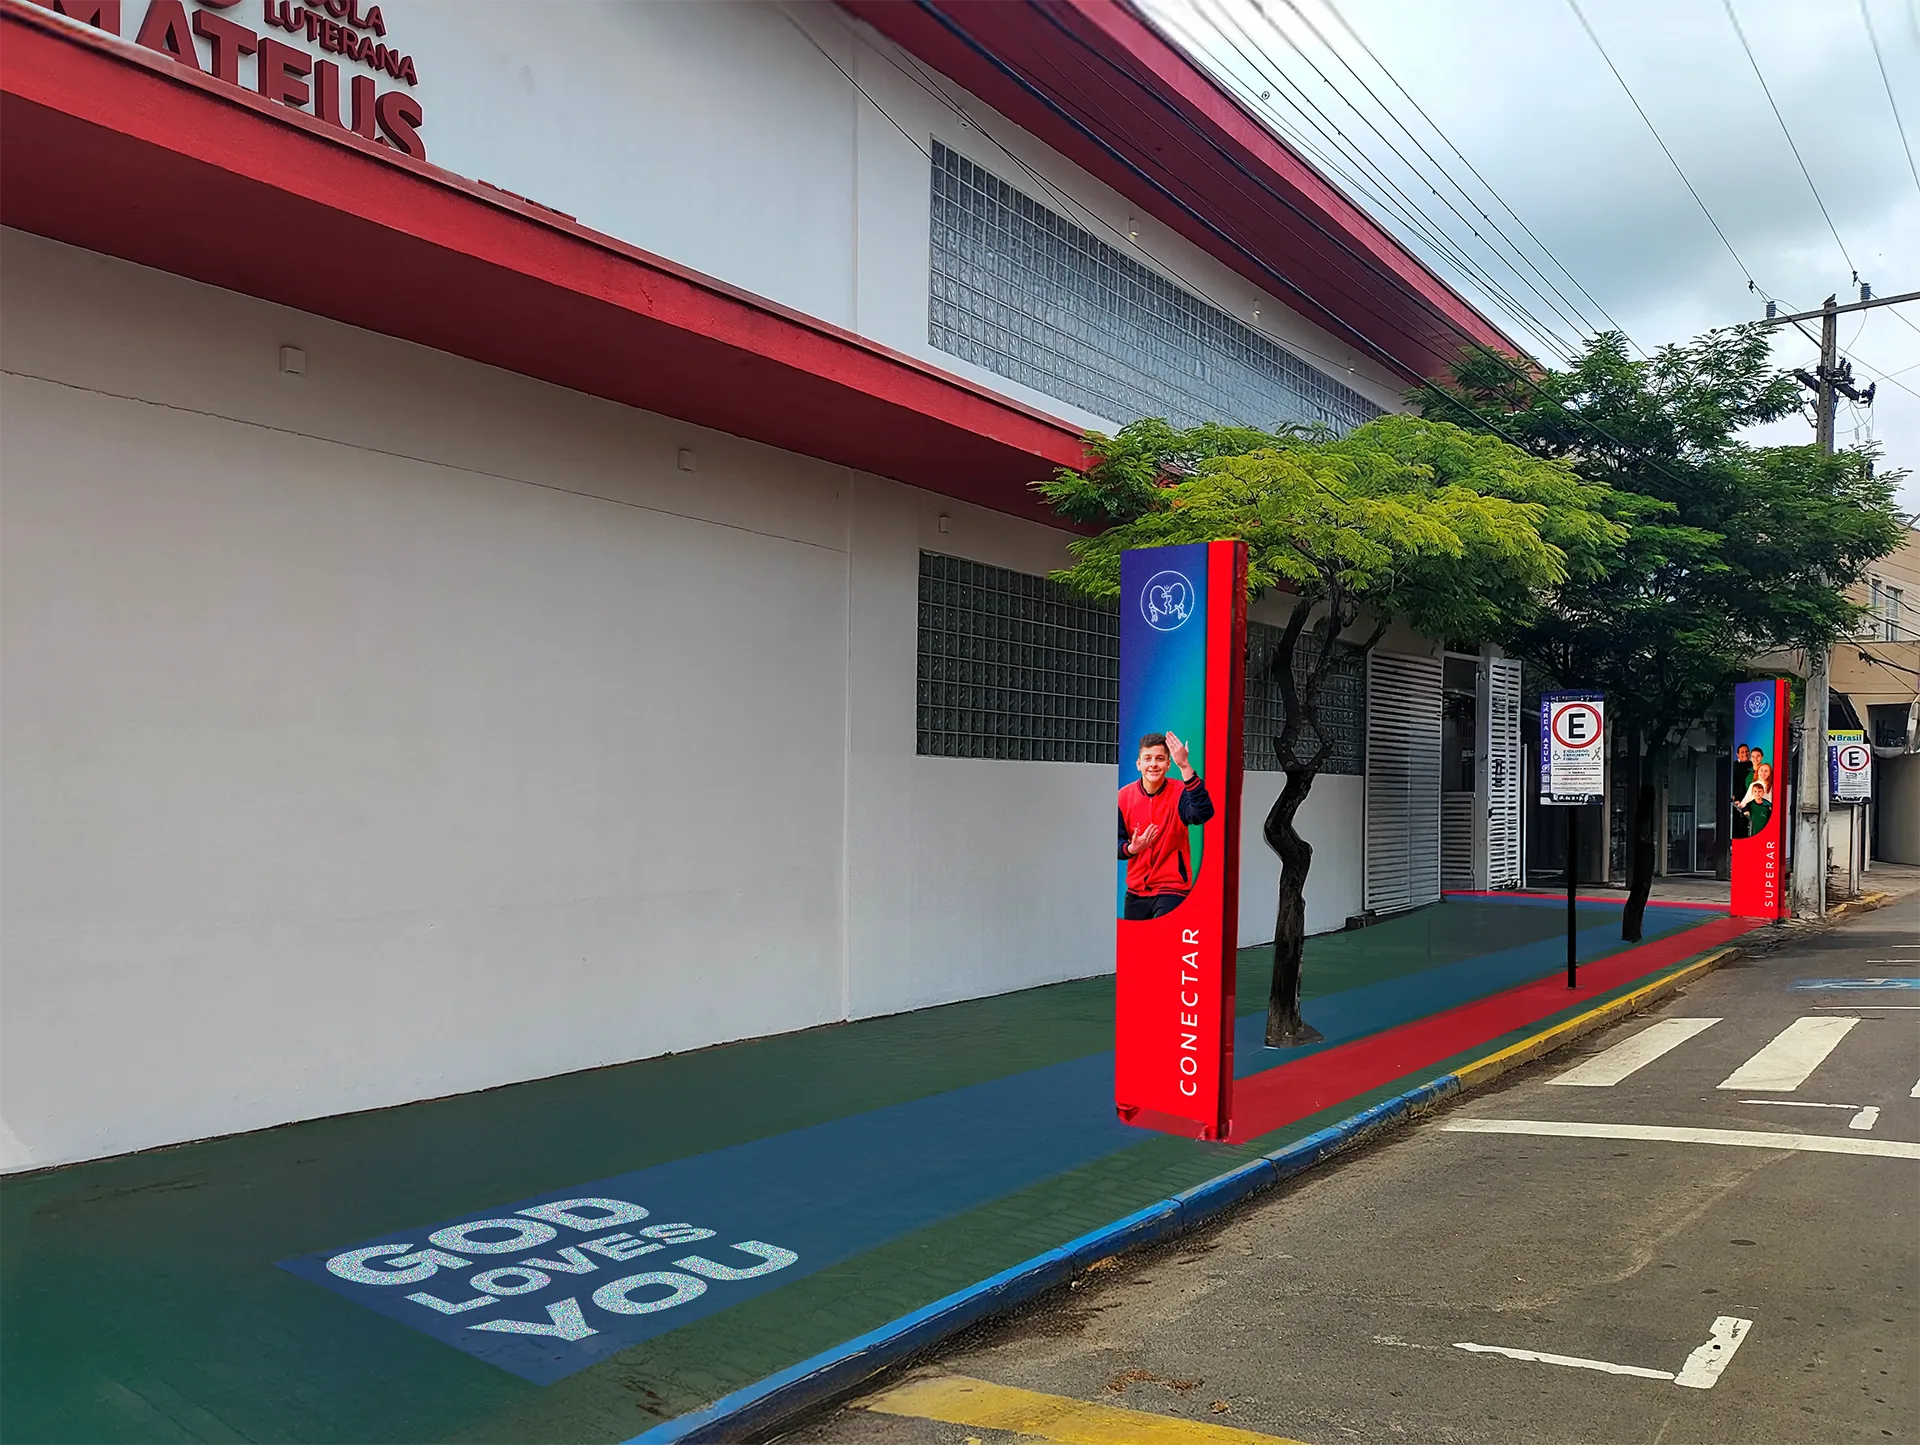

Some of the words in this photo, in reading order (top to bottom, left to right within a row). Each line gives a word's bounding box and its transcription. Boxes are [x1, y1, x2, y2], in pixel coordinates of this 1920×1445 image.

[263, 0, 419, 87] LUTERANA
[1568, 713, 1586, 739] E
[1848, 751, 1861, 767] E
[1764, 841, 1776, 907] SUPERAR
[1180, 928, 1200, 1096] CONECTAR
[326, 1196, 650, 1286] GOD
[403, 1222, 717, 1316] LOVES
[466, 1240, 800, 1342] YOU
